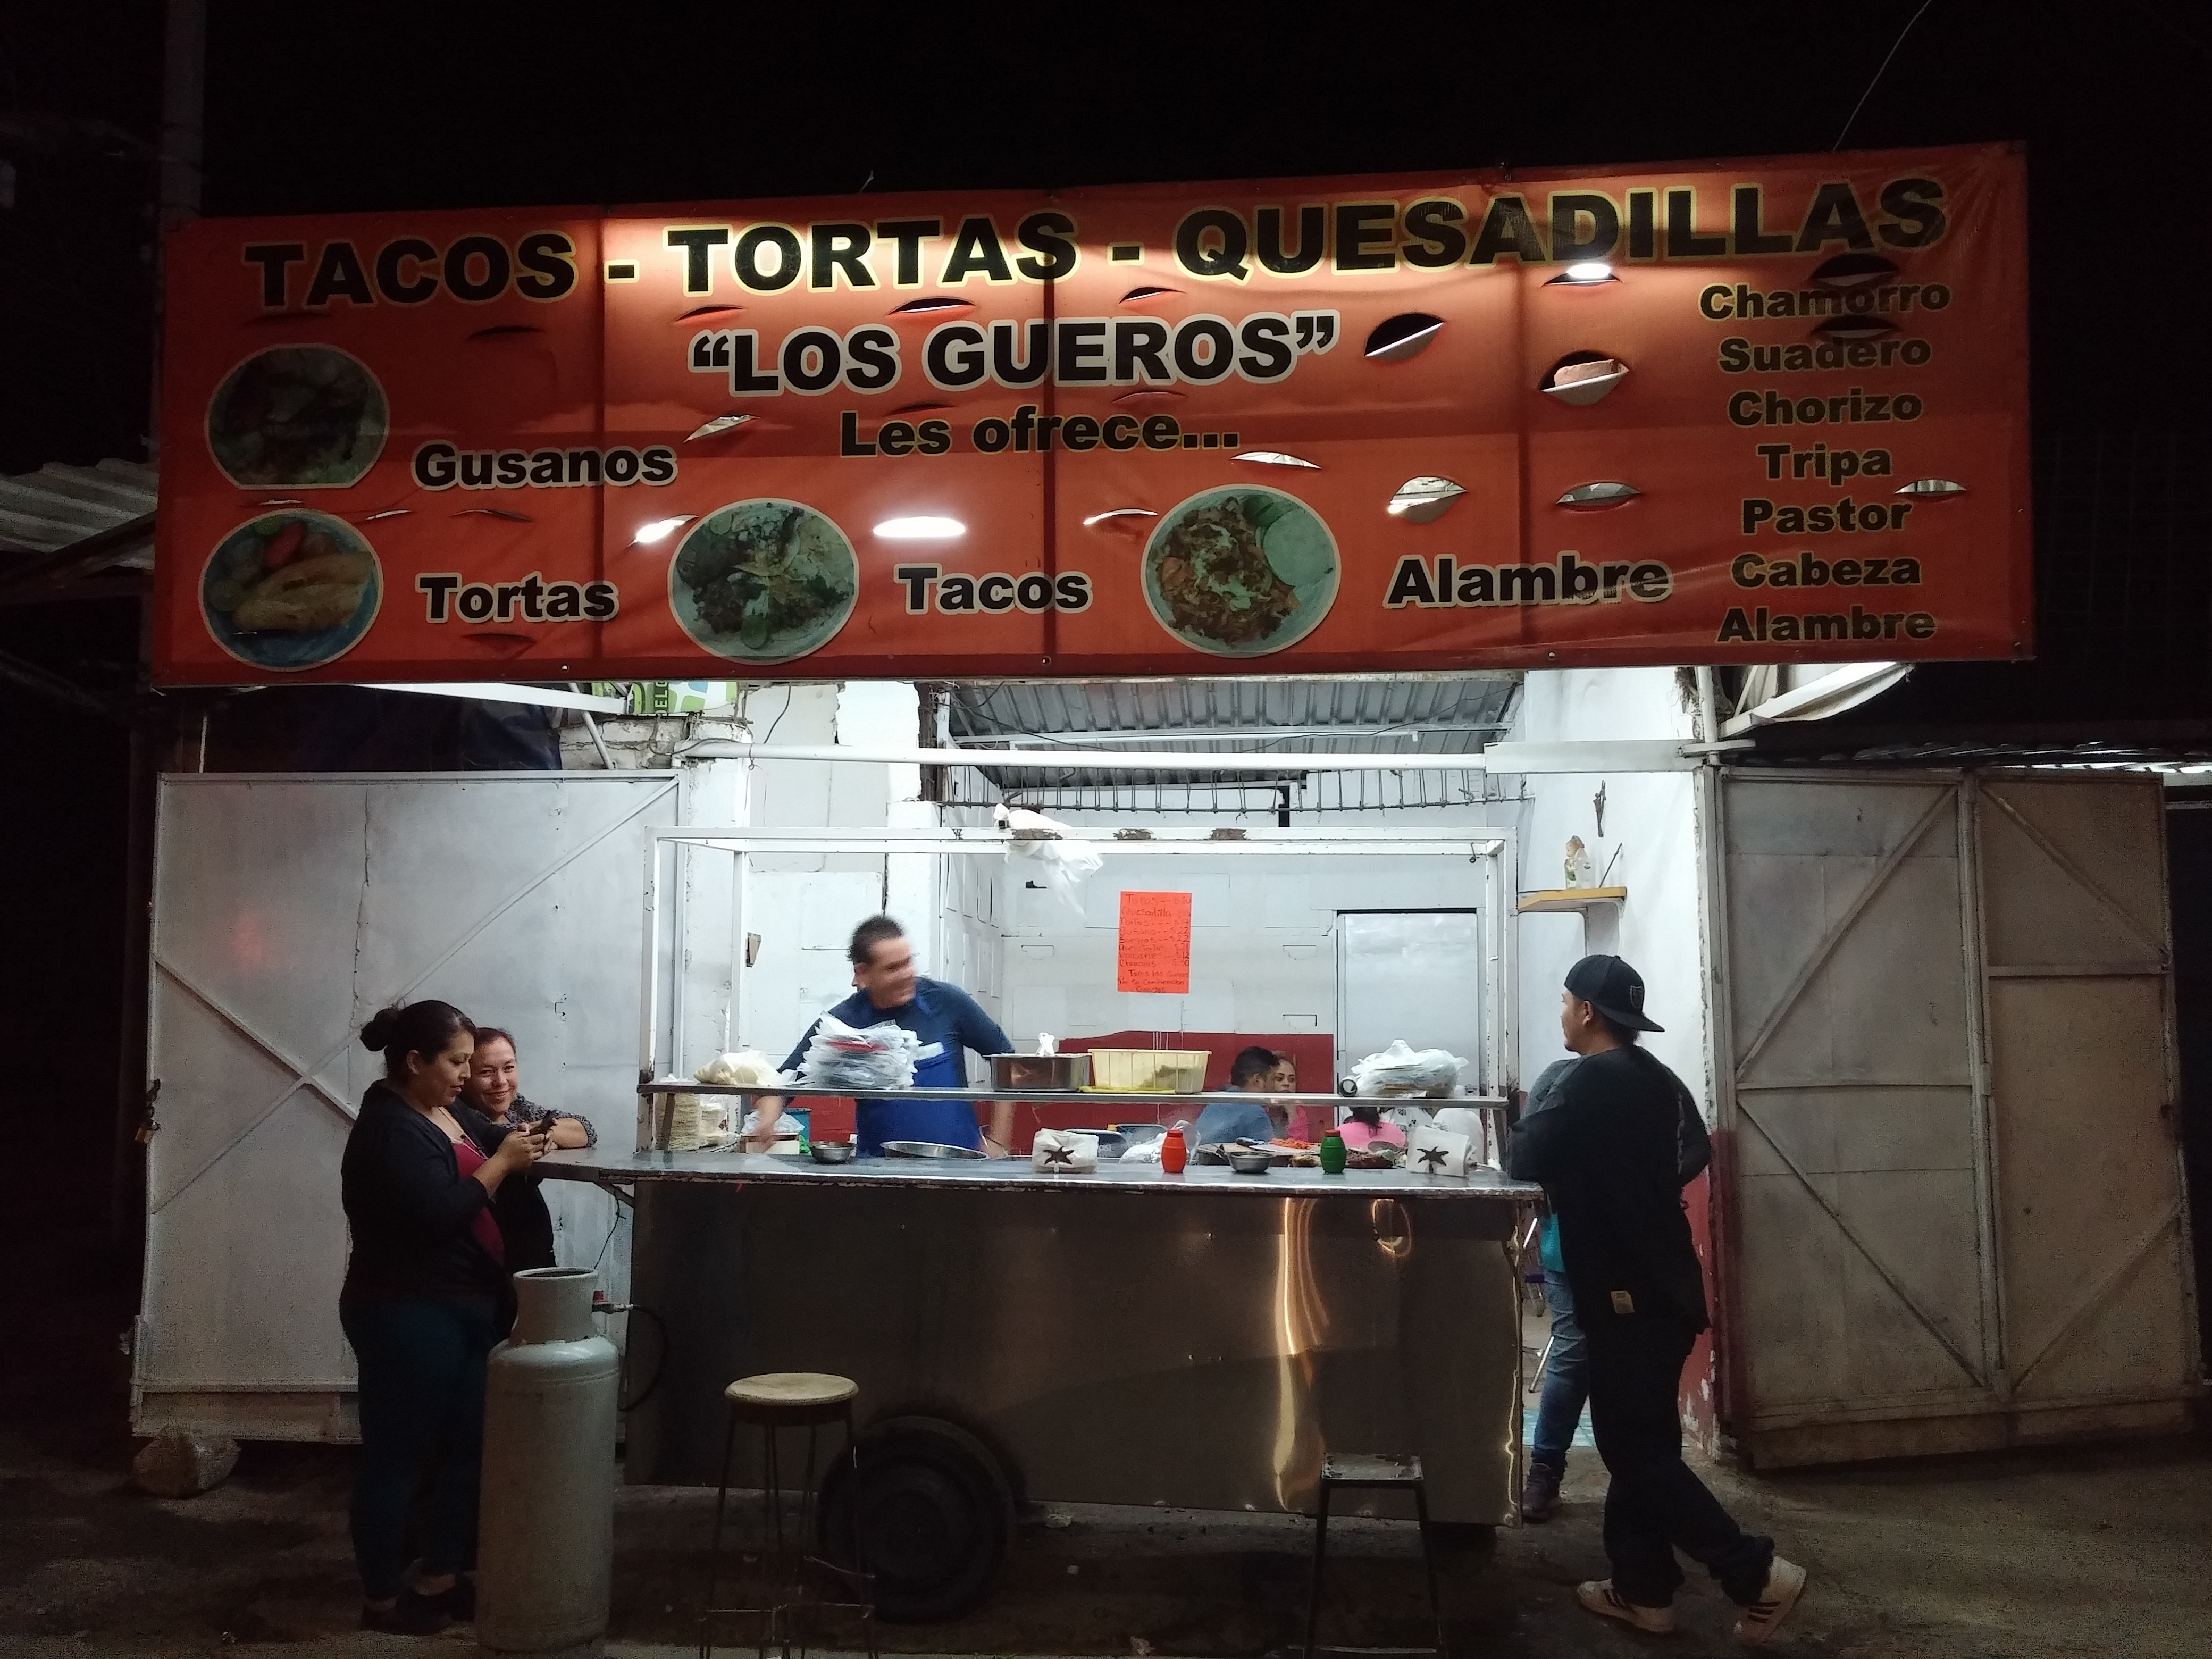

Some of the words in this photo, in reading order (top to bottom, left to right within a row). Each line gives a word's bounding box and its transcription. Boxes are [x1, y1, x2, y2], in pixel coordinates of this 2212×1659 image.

[244, 231, 577, 307] TACOS
[667, 212, 1077, 292] TORTAS
[1175, 178, 1946, 280] QUESADILLAS
[1700, 283, 1950, 319] Chamorro
[1719, 337, 1932, 372] Suadero
[1728, 387, 1922, 426] Chorizo
[839, 412, 952, 456] Les
[414, 443, 674, 487] Gusanos
[1757, 442, 1892, 485] Tripa
[1741, 497, 1913, 534] Pastor
[897, 567, 1090, 611] Tacos
[1386, 554, 1670, 605] Alambre
[1731, 552, 1922, 588] Cabeza
[418, 575, 617, 621] Tortas
[1714, 606, 1936, 643] Alambre
